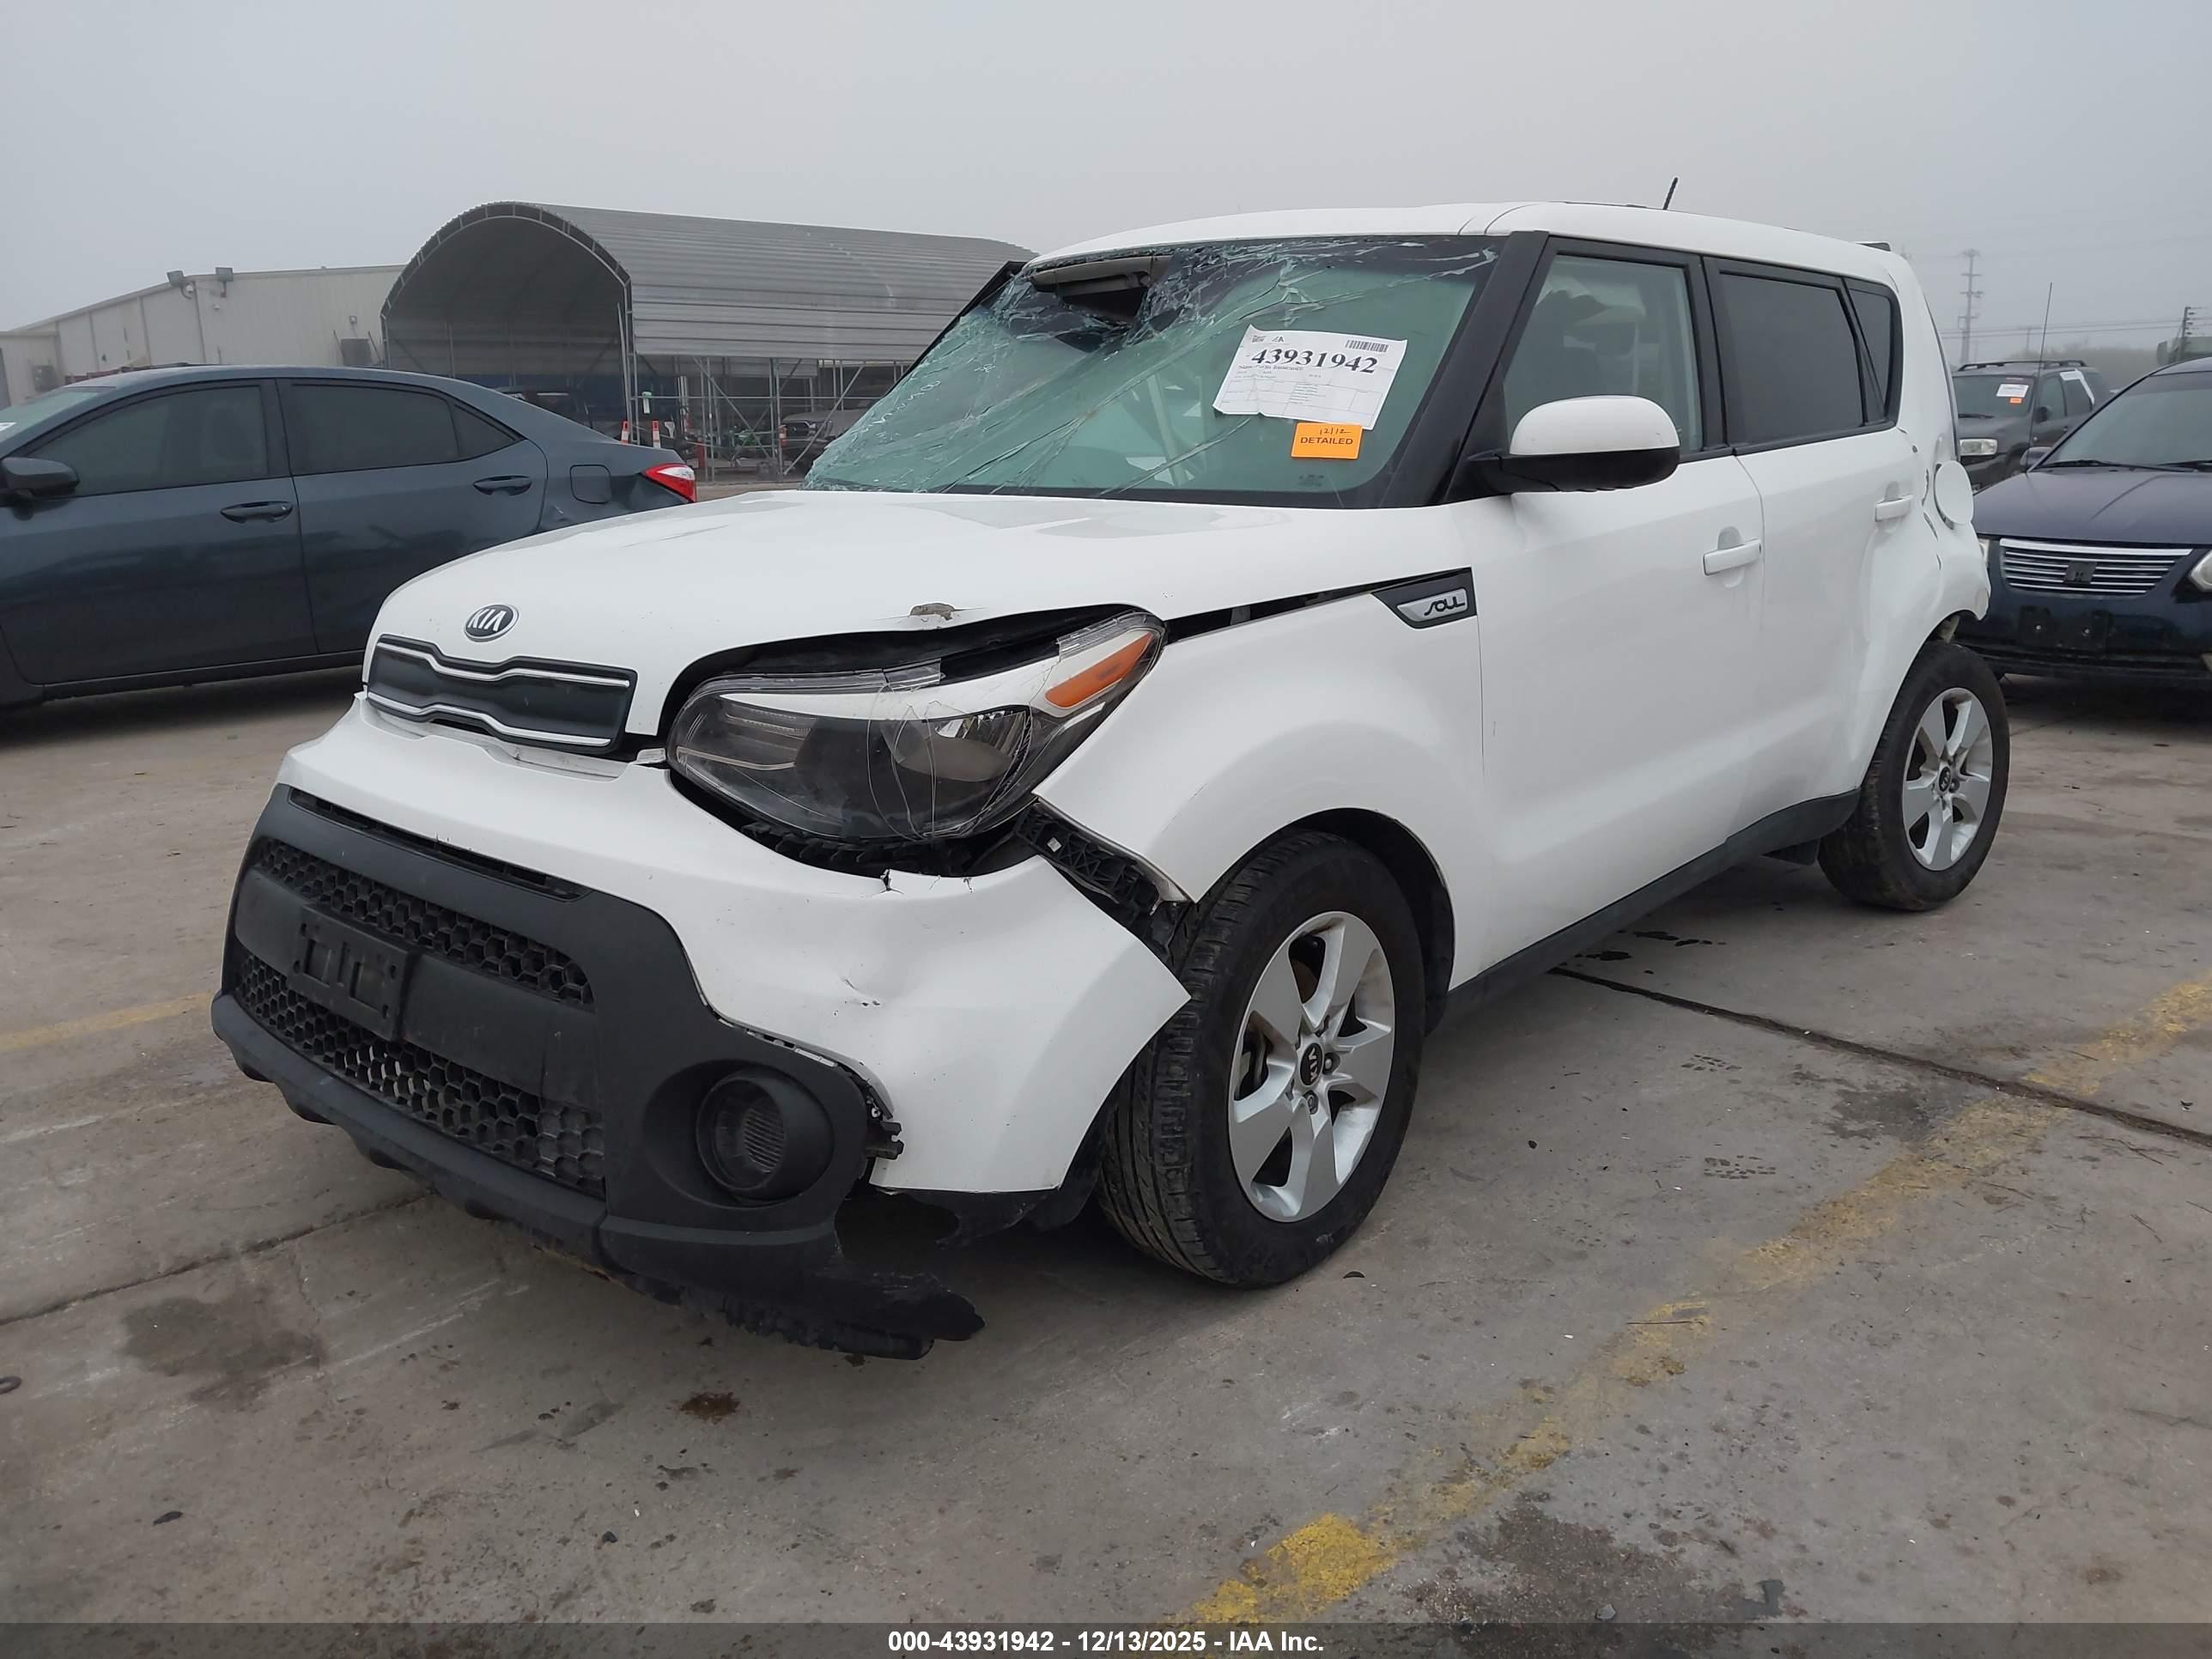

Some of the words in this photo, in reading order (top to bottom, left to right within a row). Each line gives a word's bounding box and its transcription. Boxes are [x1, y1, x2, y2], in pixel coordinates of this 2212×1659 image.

[1251, 349, 1377, 374] 43931942
[1300, 436, 1353, 445] DETAILED
[467, 608, 507, 631] KIA
